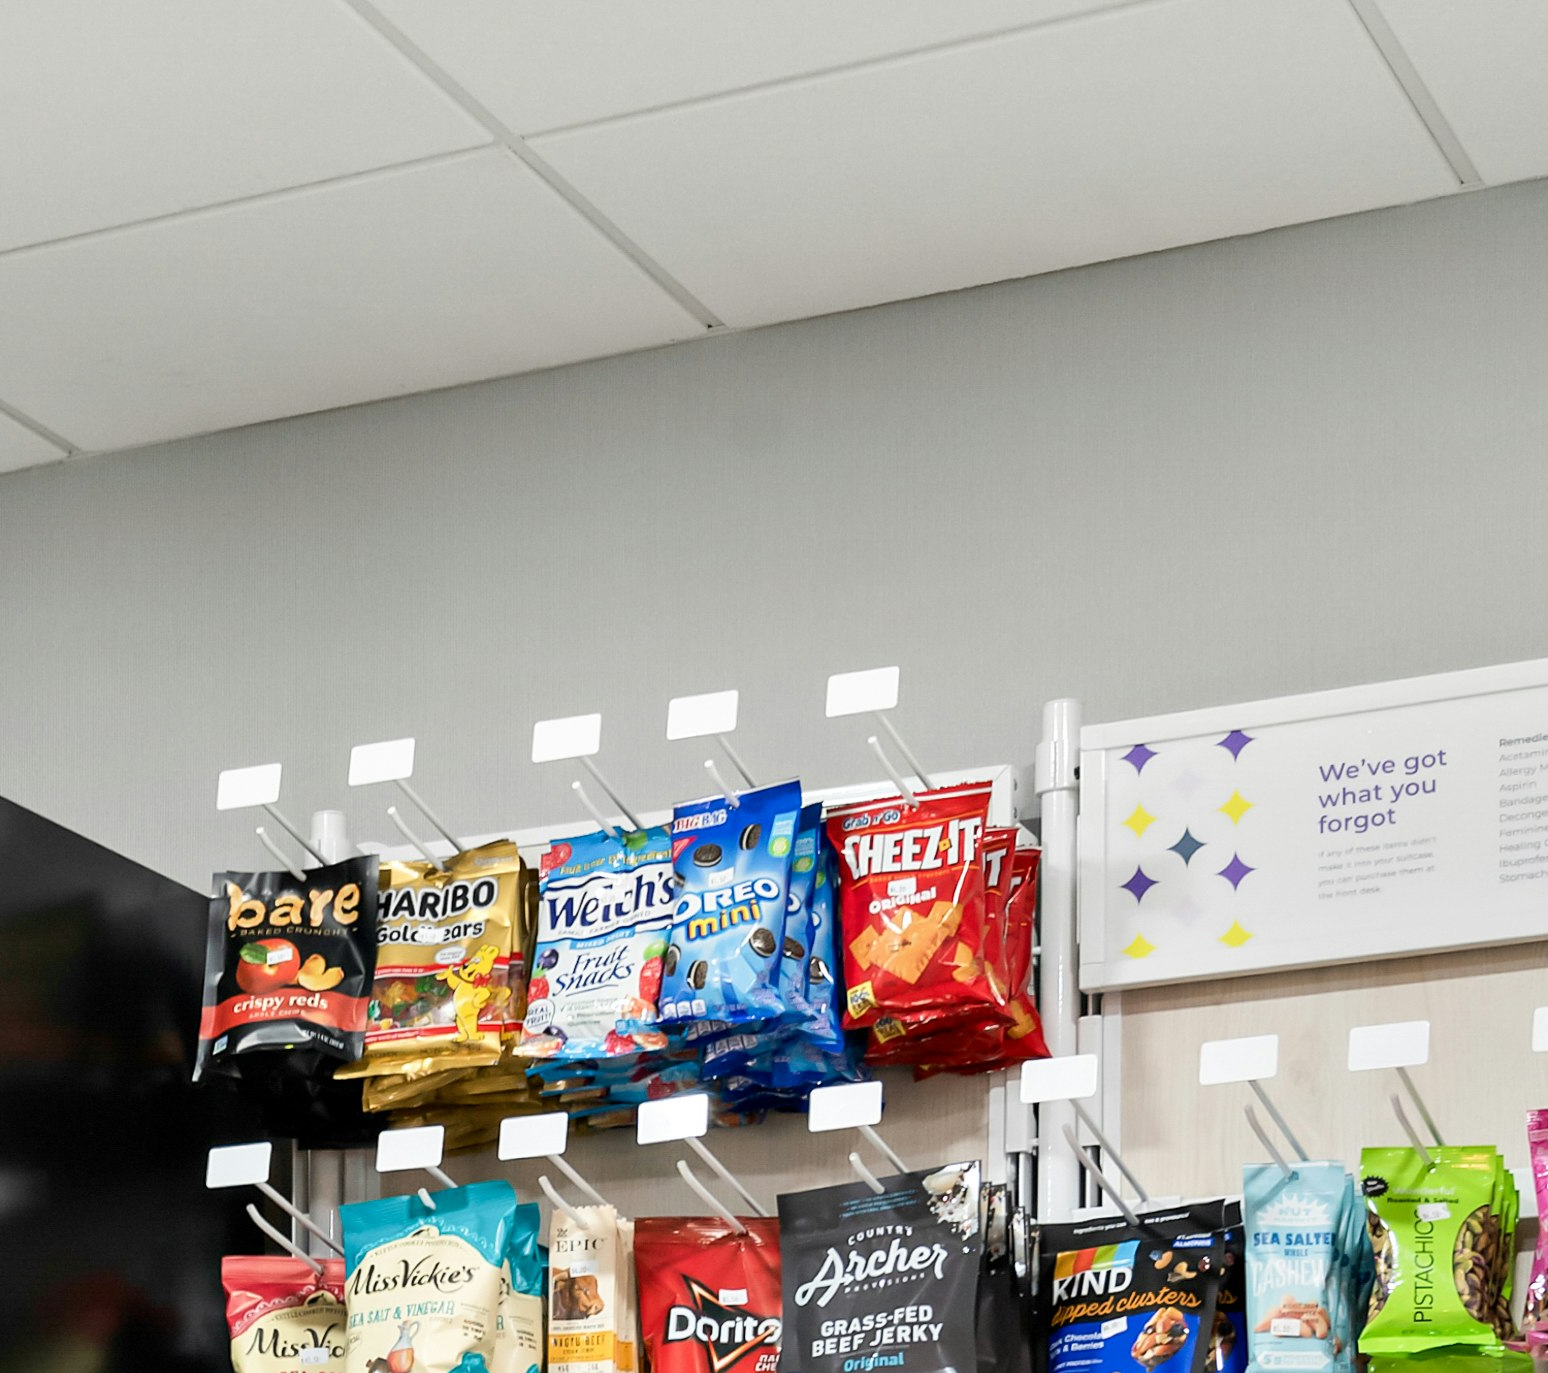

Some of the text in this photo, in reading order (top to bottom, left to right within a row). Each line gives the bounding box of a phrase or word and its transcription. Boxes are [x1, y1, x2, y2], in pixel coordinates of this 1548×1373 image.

[1319, 749, 1447, 782] We've got
[1318, 779, 1436, 808] what you
[1499, 780, 1537, 793] Aspirin
[675, 809, 727, 832] BIG BAG
[1318, 809, 1396, 834] forgot
[1499, 841, 1541, 853] Healing
[1499, 869, 1548, 883] Stomach
[226, 880, 360, 931] bare
[376, 877, 497, 921] HARIBO
[674, 878, 779, 921] OREO
[689, 900, 761, 939] mini
[571, 944, 629, 974] Fruit
[554, 960, 635, 996] Snacks
[233, 993, 328, 1014] crispy reds
[555, 1238, 604, 1253] EPIC
[794, 1237, 948, 1308] Archer
[1052, 1267, 1133, 1306] KIND
[349, 1300, 455, 1327] SEA SALT VINEGAR
[820, 1305, 934, 1338] GRASS-FED
[811, 1322, 943, 1358] BEEF JERKY
[843, 1351, 904, 1372] Original
